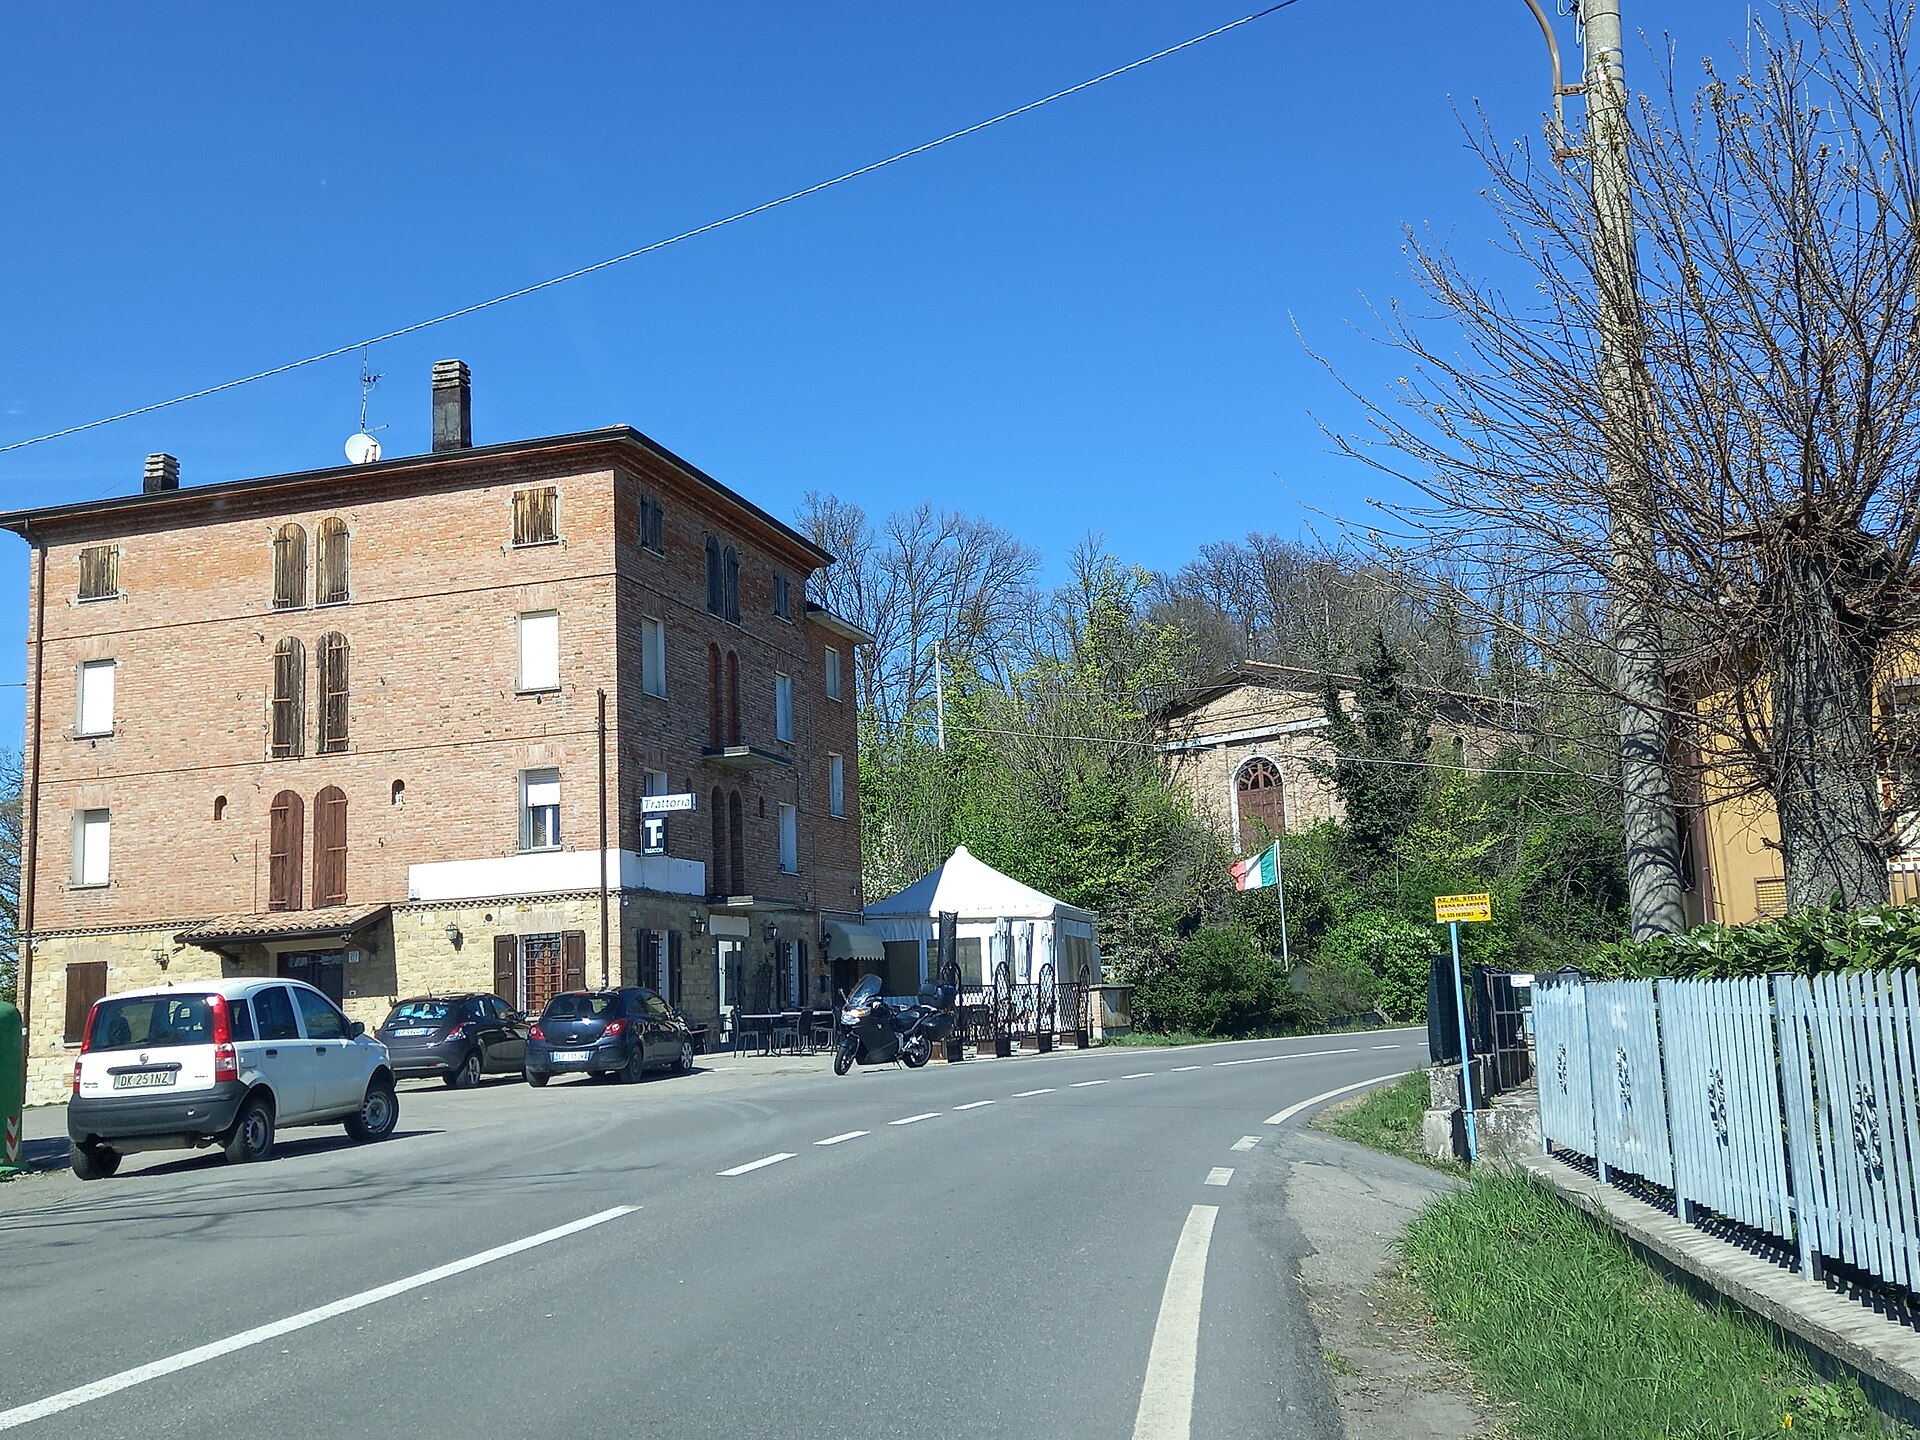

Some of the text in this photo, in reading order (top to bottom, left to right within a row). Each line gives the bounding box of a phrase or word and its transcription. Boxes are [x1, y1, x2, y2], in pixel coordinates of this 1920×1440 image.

[644, 799, 690, 809] Trattoria
[120, 1072, 169, 1087] DK 251NZ
